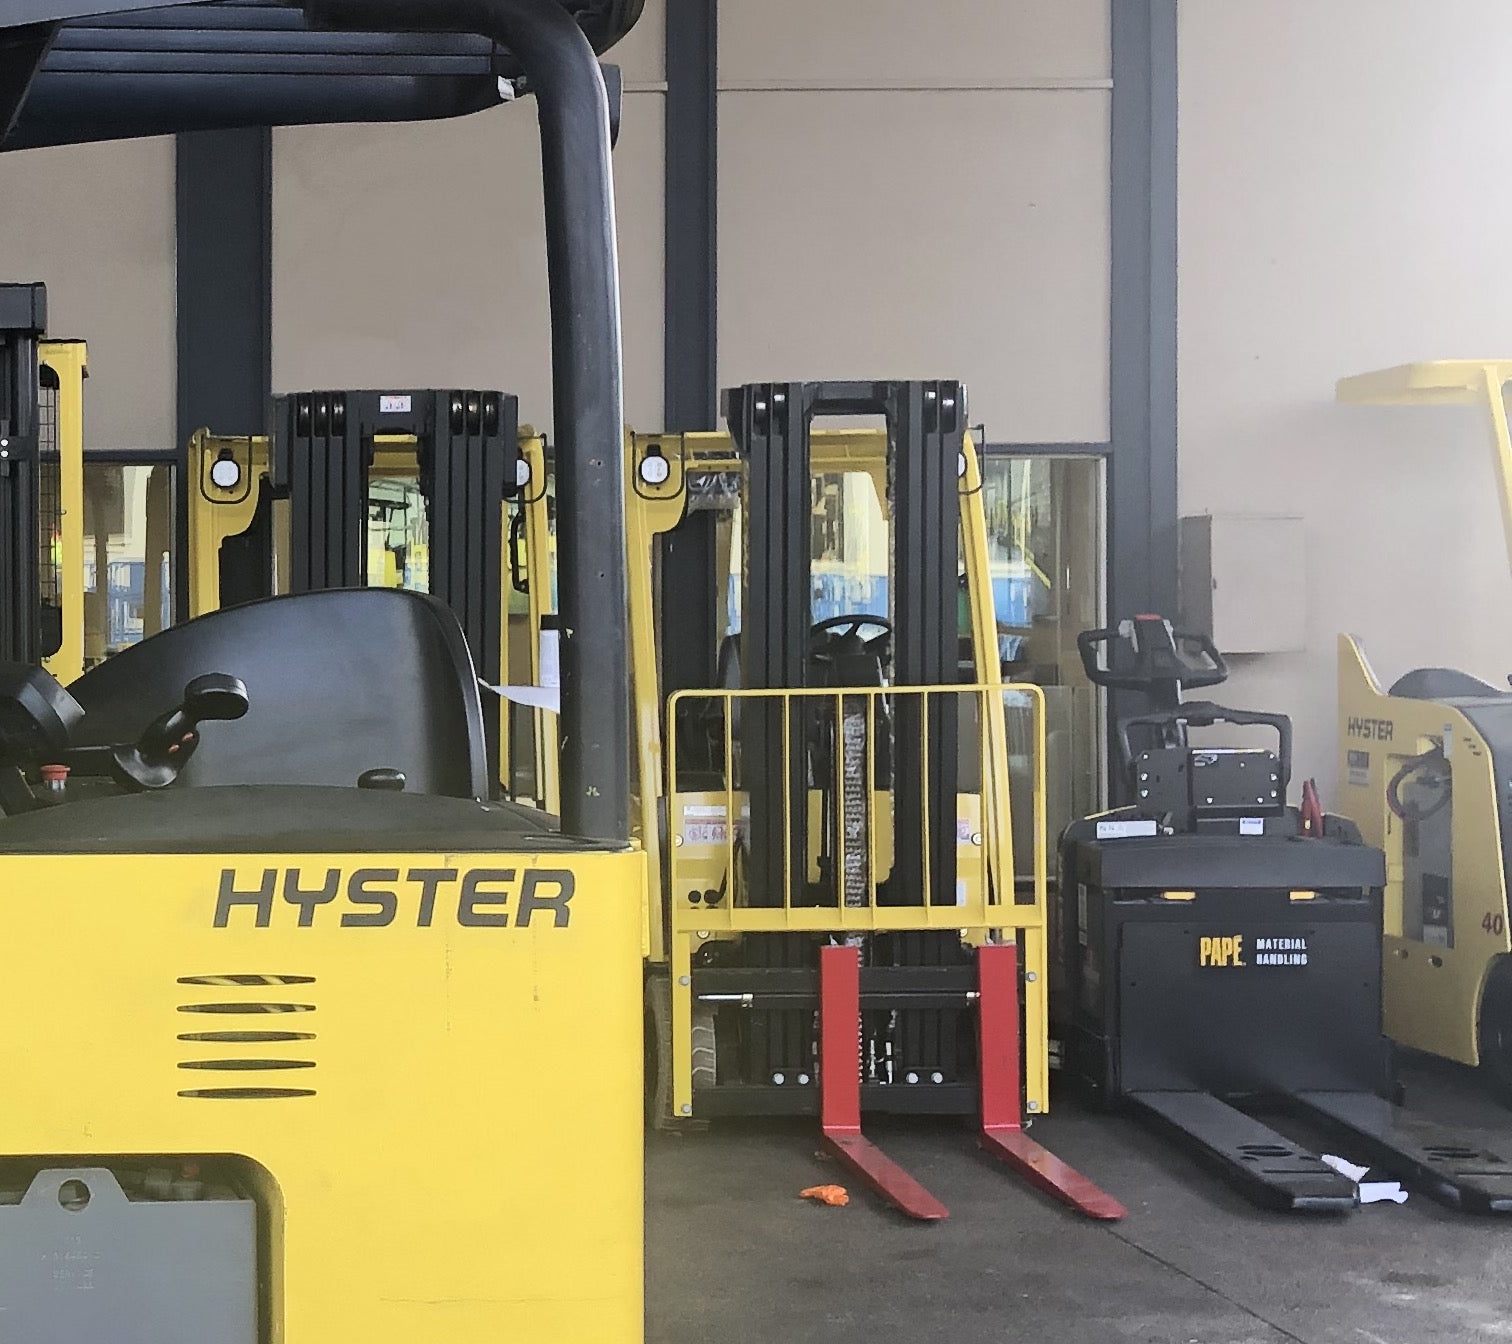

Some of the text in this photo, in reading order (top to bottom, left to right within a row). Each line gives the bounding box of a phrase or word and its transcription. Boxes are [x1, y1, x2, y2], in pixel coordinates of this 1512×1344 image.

[1347, 716, 1393, 741] HYSTER
[212, 868, 575, 928] HYSTER
[1482, 912, 1503, 936] 40
[1256, 939, 1307, 950] MATERIAL
[1256, 953, 1308, 965] HANDLING
